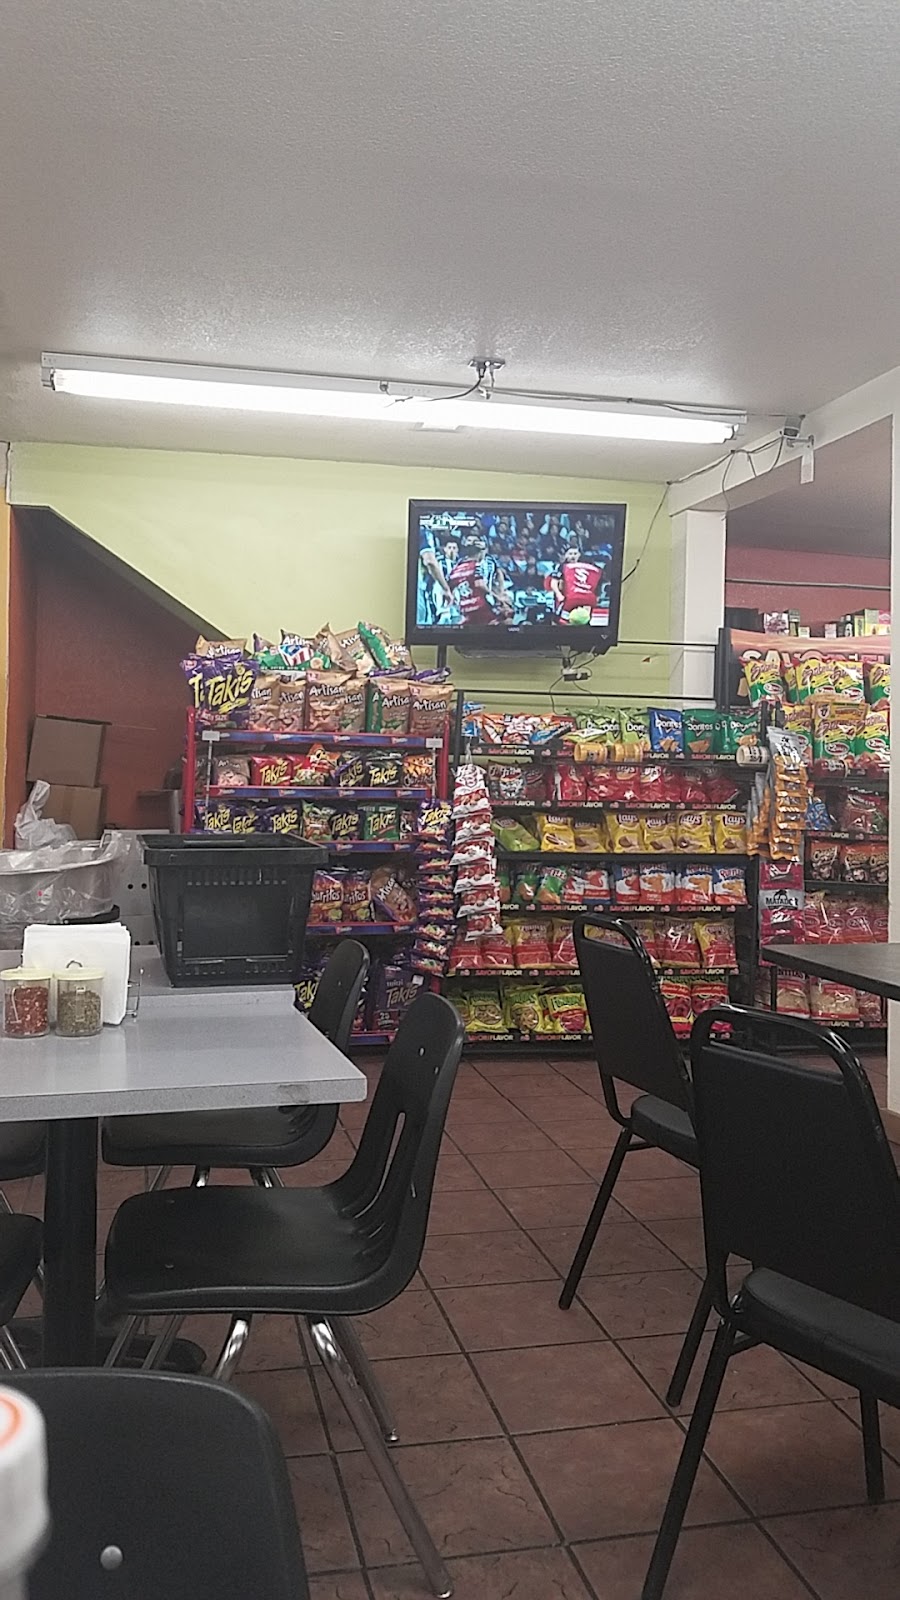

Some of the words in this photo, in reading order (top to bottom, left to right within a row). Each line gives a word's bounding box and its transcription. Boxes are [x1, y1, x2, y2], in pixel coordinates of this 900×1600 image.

[205, 669, 254, 710] Takis
[309, 684, 344, 697] Artisan
[413, 700, 447, 712] Artisan
[260, 760, 288, 786] Takis
[369, 765, 398, 787] Takis
[271, 809, 298, 833] Takis
[331, 813, 359, 835] Takis
[367, 811, 396, 835] Takis
[294, 980, 319, 1003] Taki
[386, 985, 418, 1008] Takis
